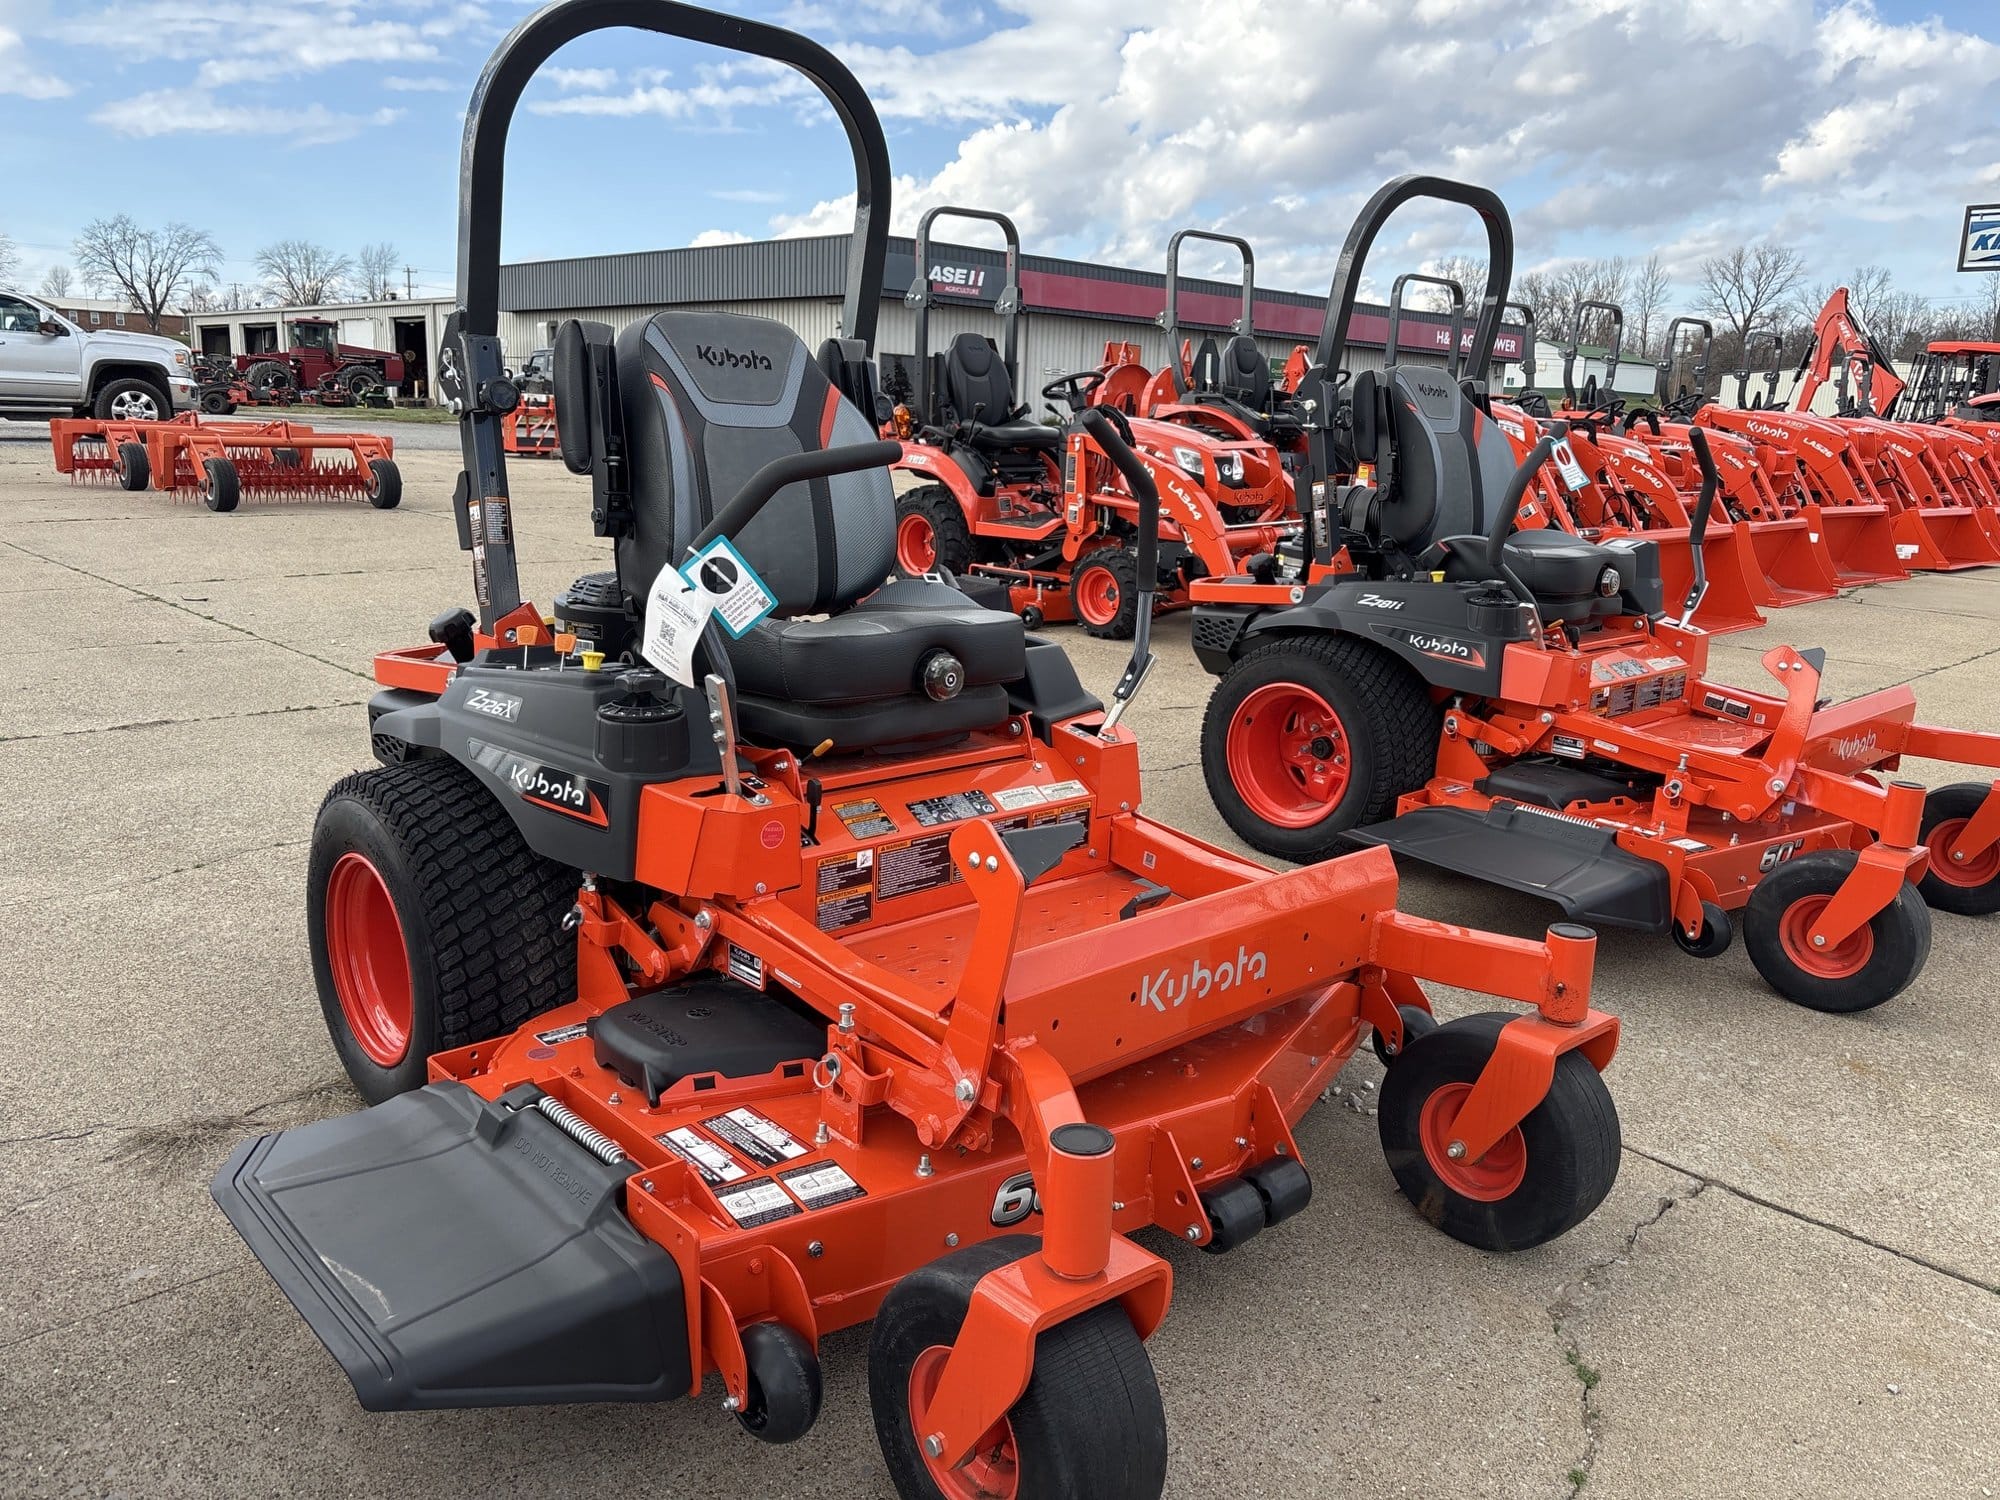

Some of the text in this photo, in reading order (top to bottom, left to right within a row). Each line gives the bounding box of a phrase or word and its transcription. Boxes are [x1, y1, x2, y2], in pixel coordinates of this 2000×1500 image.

[928, 265, 967, 286] ASE
[944, 285, 980, 296] AGRICULTURE
[696, 344, 772, 371] Kubota
[1418, 383, 1448, 399] Kubota
[1746, 419, 1789, 440] Kubota
[1803, 437, 1834, 458] LA526
[1631, 464, 1664, 489] LA340
[1168, 480, 1202, 520] LA344
[1233, 489, 1264, 503] Kubota
[1357, 593, 1405, 611] Z781i
[1409, 634, 1468, 657] Kubota
[466, 688, 521, 719] Z726X
[1837, 728, 1877, 761] Kubota
[510, 764, 585, 807] Kubota
[1140, 945, 1267, 1012] Kubota
[514, 1136, 593, 1206] DO NOT REMOVE
[990, 1171, 1043, 1228] 6
